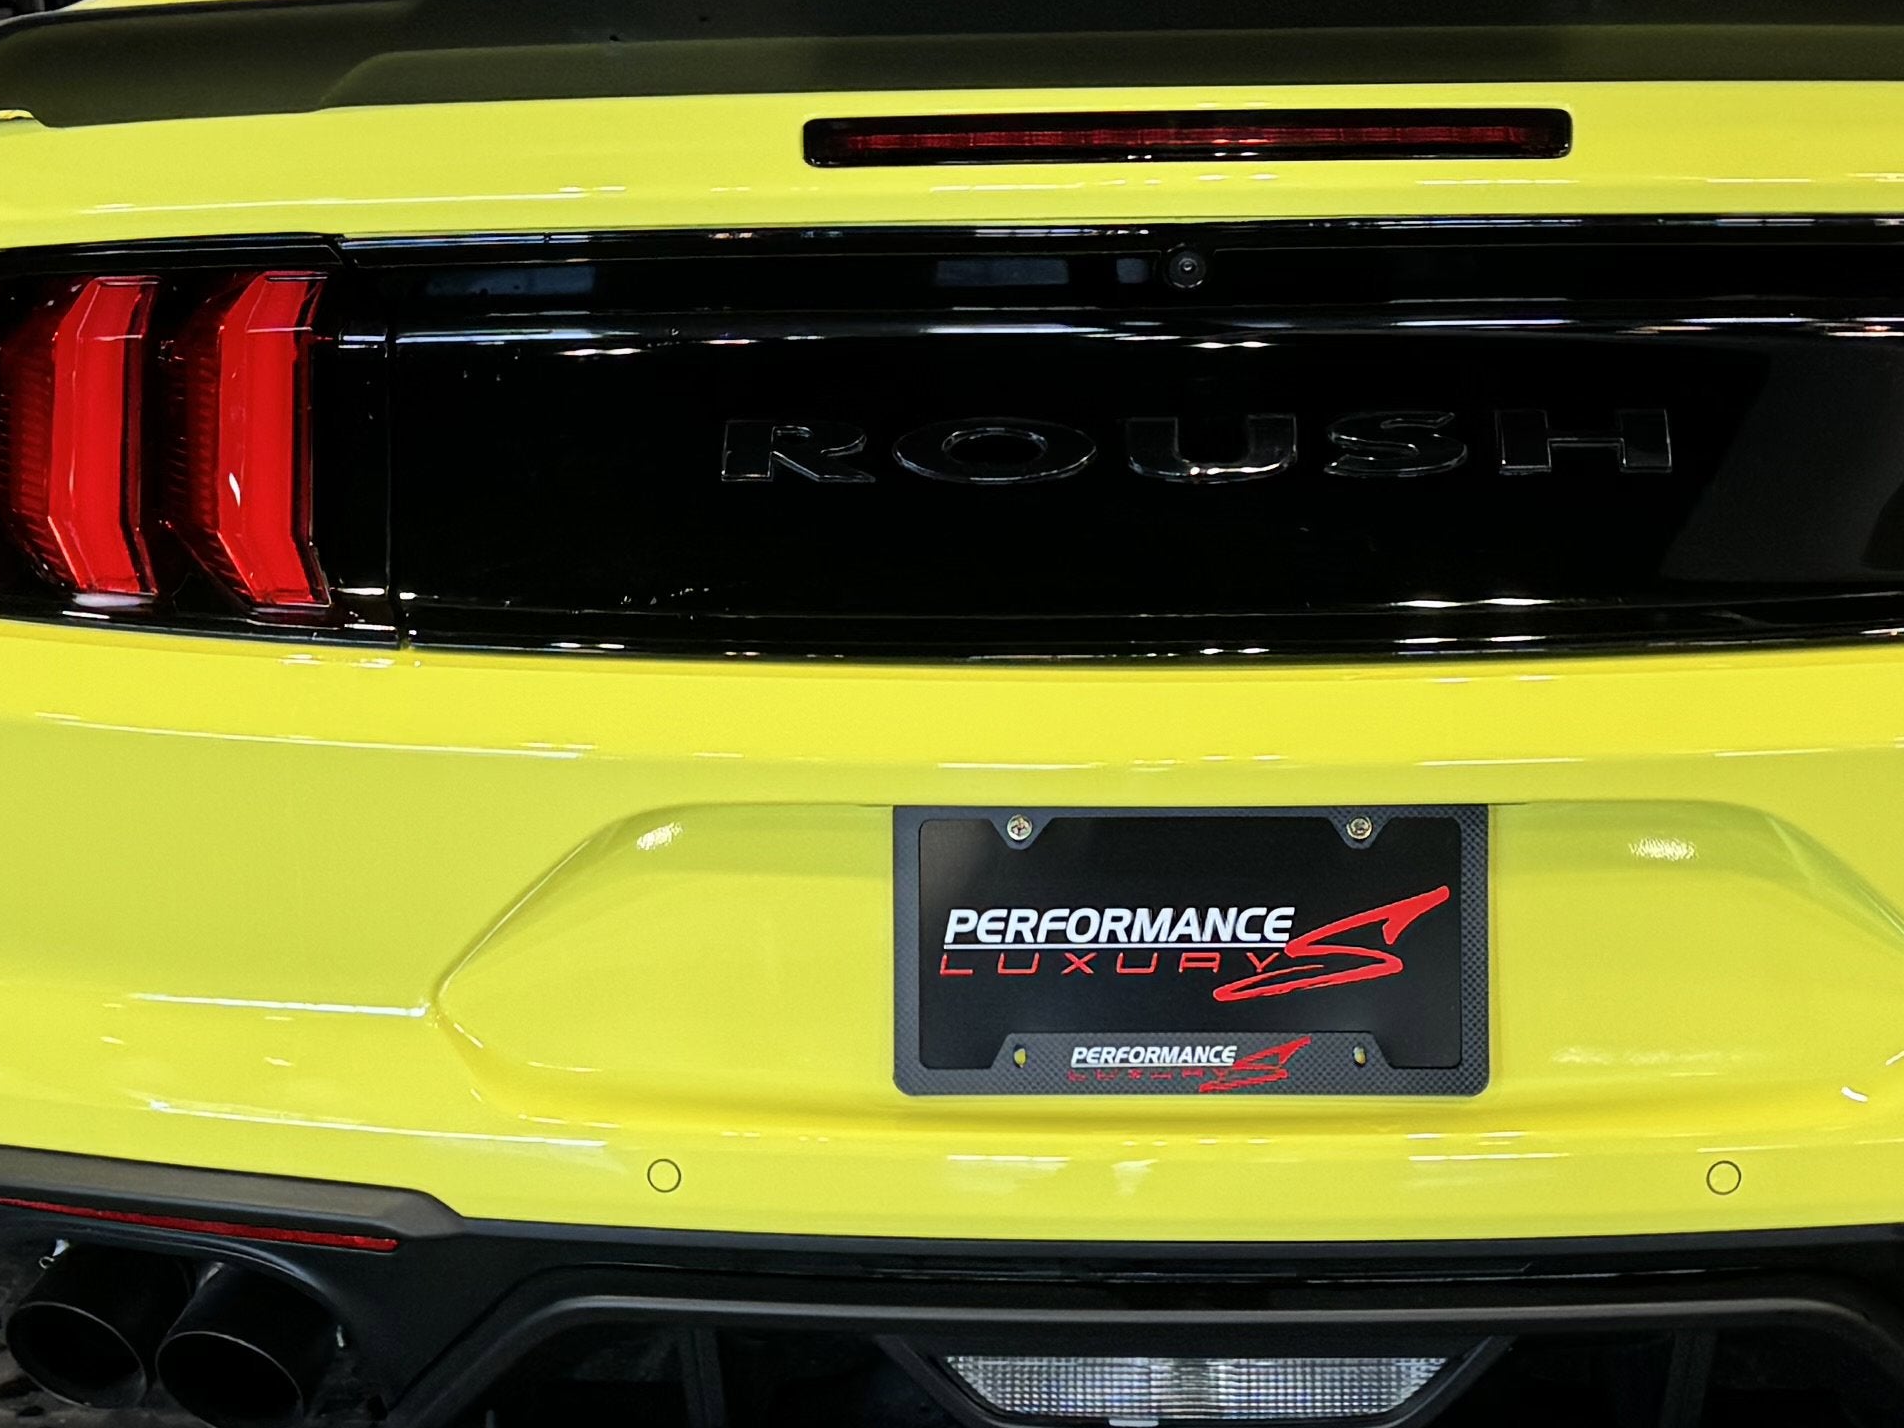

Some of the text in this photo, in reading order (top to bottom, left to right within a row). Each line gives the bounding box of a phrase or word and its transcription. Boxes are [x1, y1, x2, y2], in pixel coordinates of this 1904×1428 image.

[720, 409, 1672, 483] ROUSH
[944, 907, 1295, 944] PERFORMANCE
[938, 952, 1282, 976] LUXURY
[1071, 1045, 1238, 1065] PERFORMANCE
